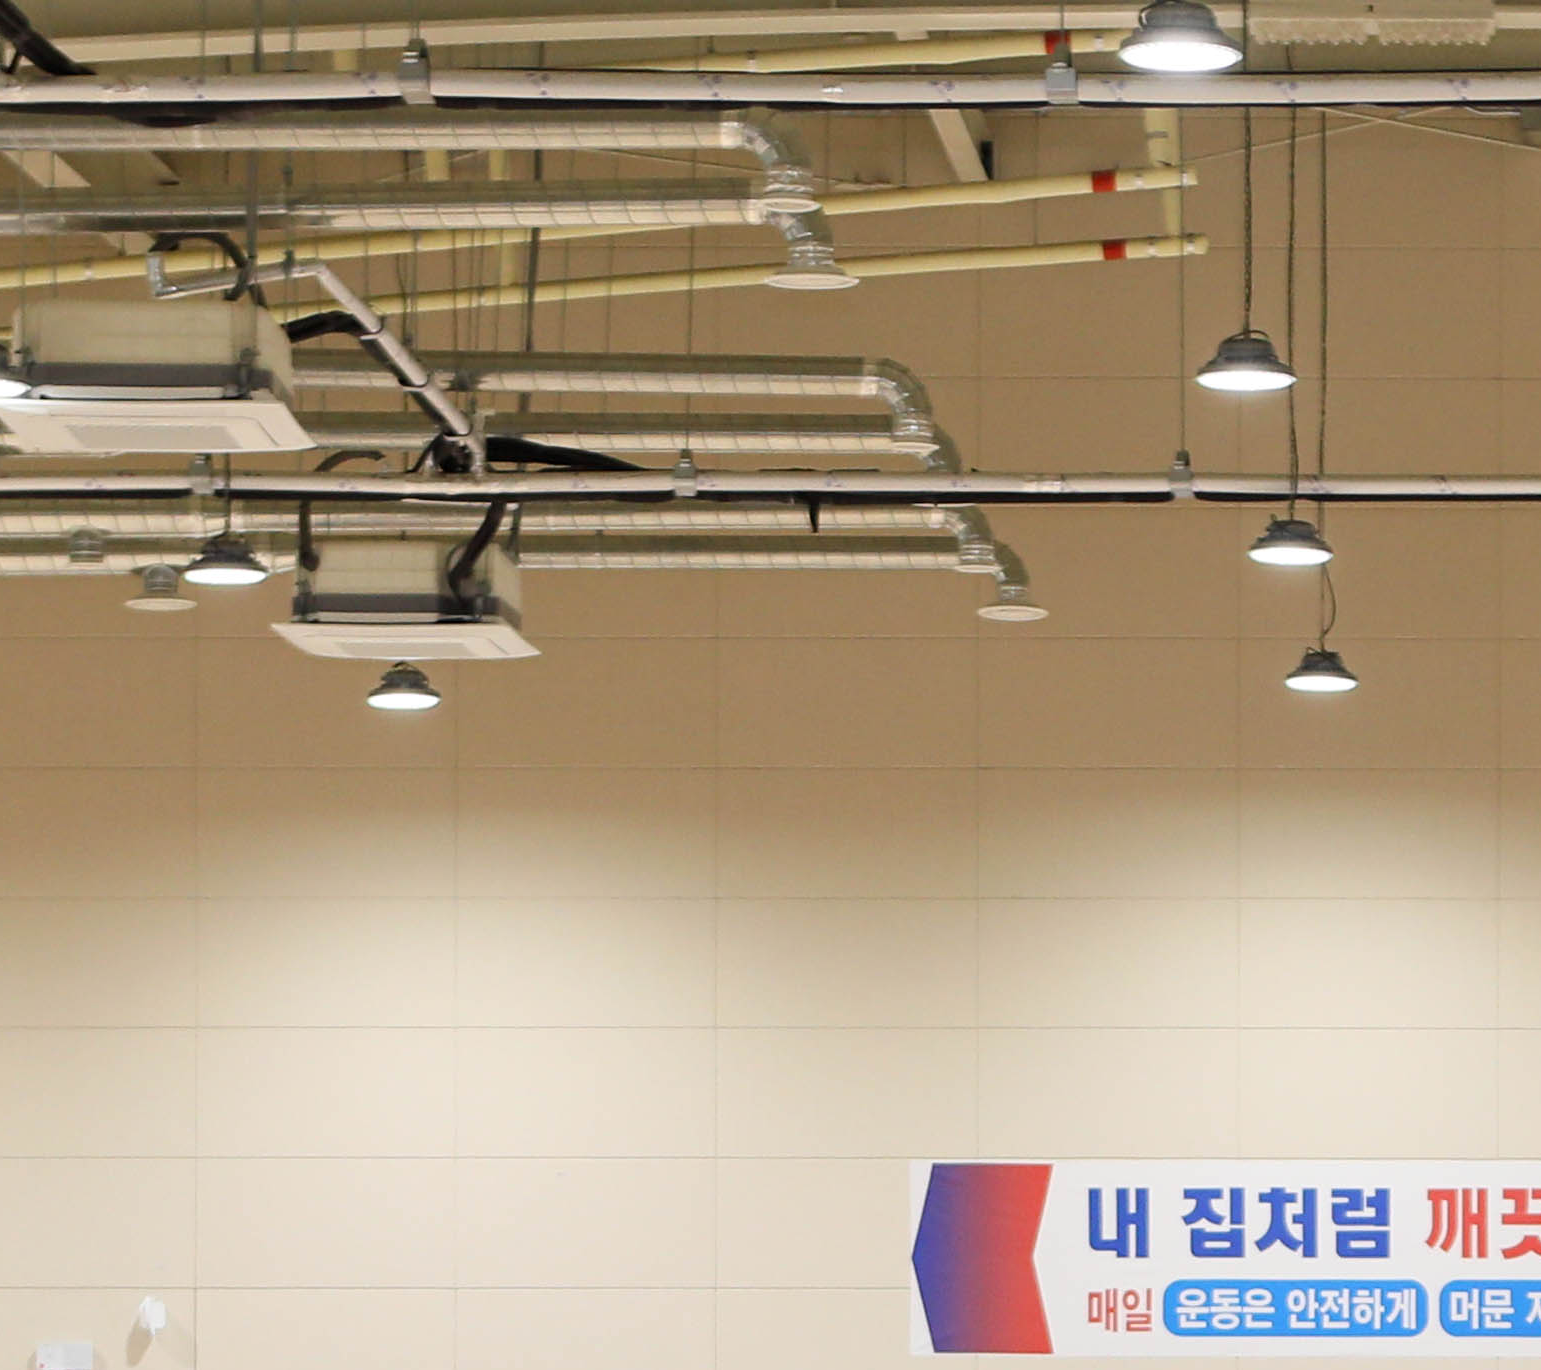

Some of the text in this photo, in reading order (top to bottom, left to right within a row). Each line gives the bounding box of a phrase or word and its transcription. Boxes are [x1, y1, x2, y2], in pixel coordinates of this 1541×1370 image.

[1088, 1188, 1150, 1259] 내
[1181, 1188, 1392, 1259] 집처럼
[1087, 1288, 1154, 1333] 매일
[1175, 1288, 1275, 1331] 운동은
[1286, 1288, 1419, 1331] 안전하게
[1448, 1289, 1515, 1331] 머문
